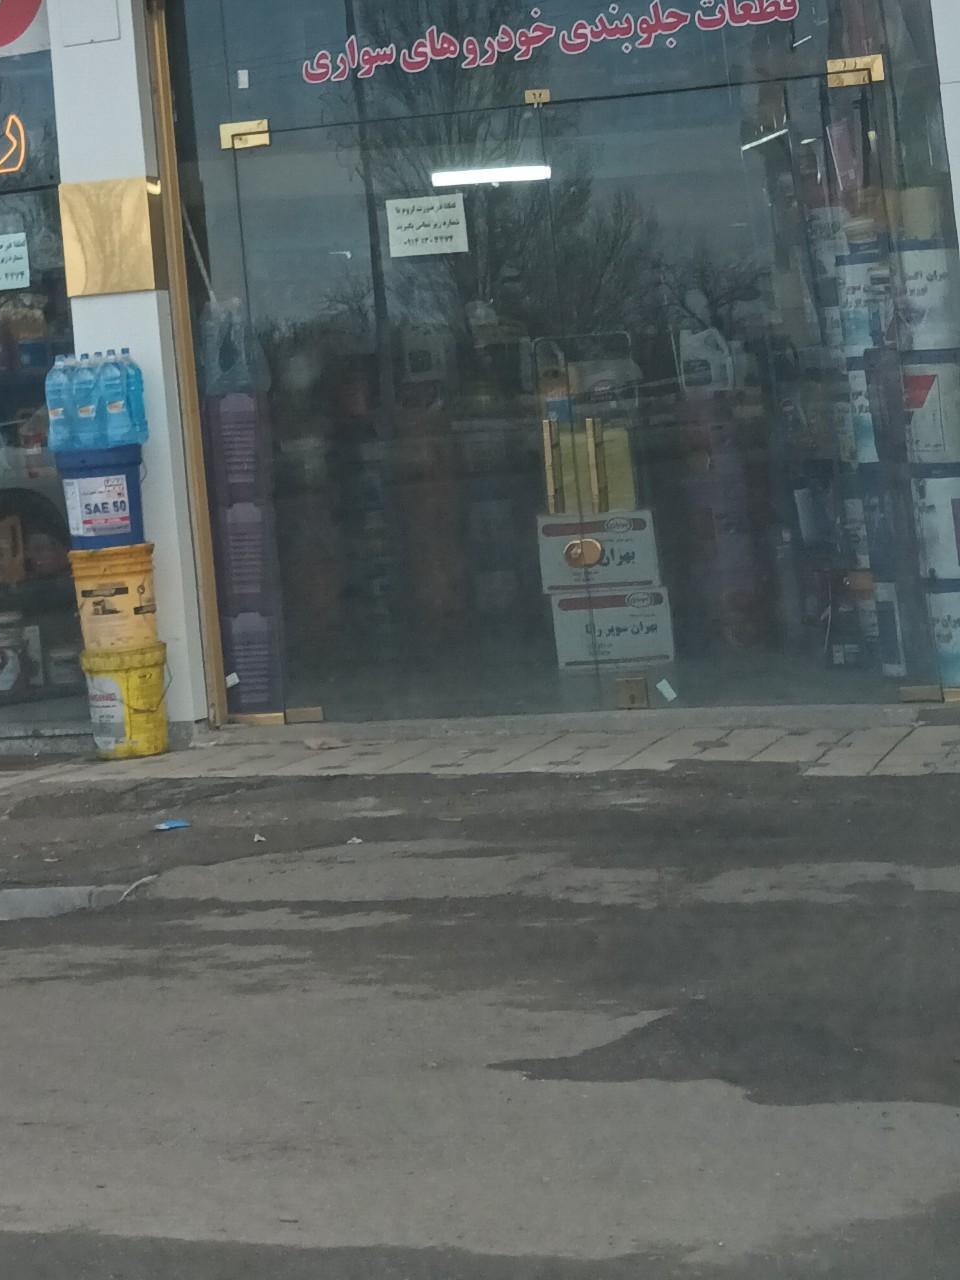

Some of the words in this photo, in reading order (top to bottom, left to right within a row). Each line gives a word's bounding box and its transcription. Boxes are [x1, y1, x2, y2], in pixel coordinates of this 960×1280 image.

[302, 35, 396, 84] سواری
[84, 501, 110, 515] SAE
[112, 499, 127, 513] 50
